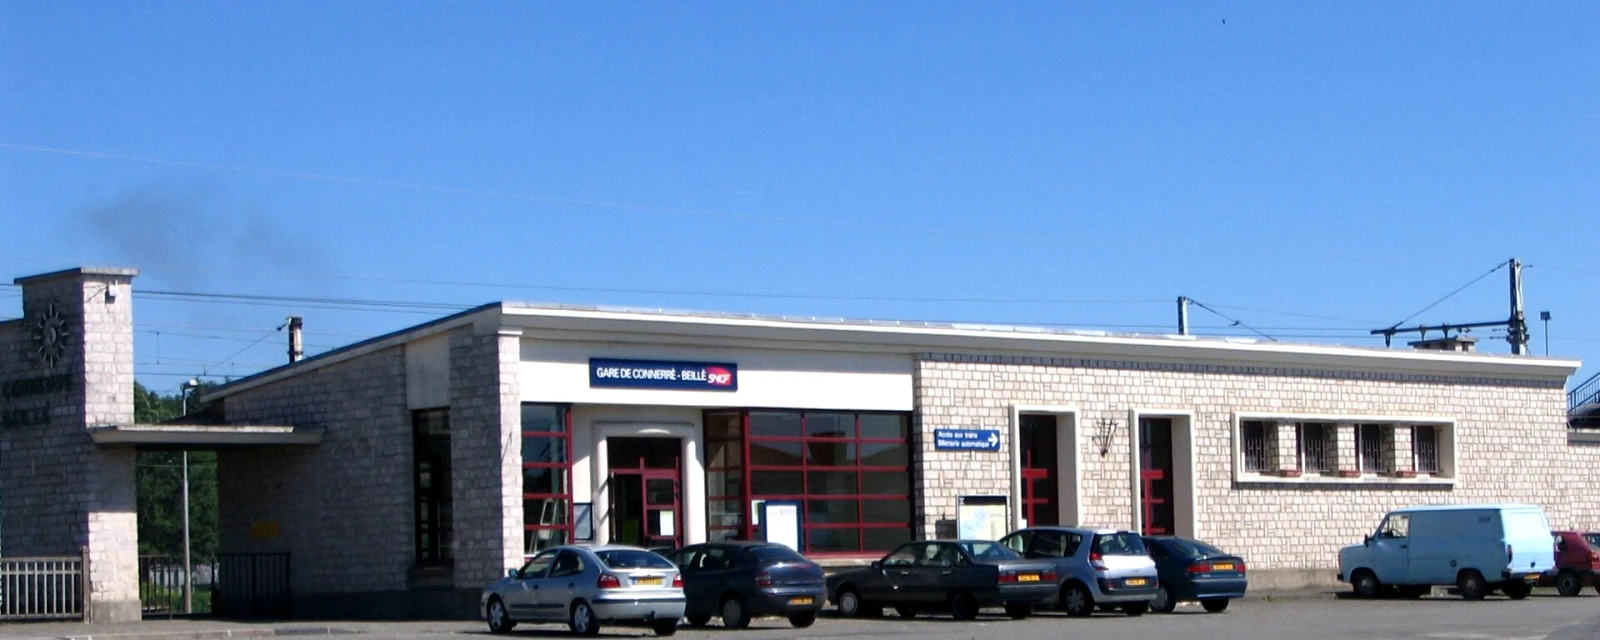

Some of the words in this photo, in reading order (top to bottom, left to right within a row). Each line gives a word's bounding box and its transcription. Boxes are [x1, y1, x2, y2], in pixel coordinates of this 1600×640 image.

[596, 367, 619, 378] GARE
[620, 368, 632, 379] DE
[707, 373, 731, 384] SNCF
